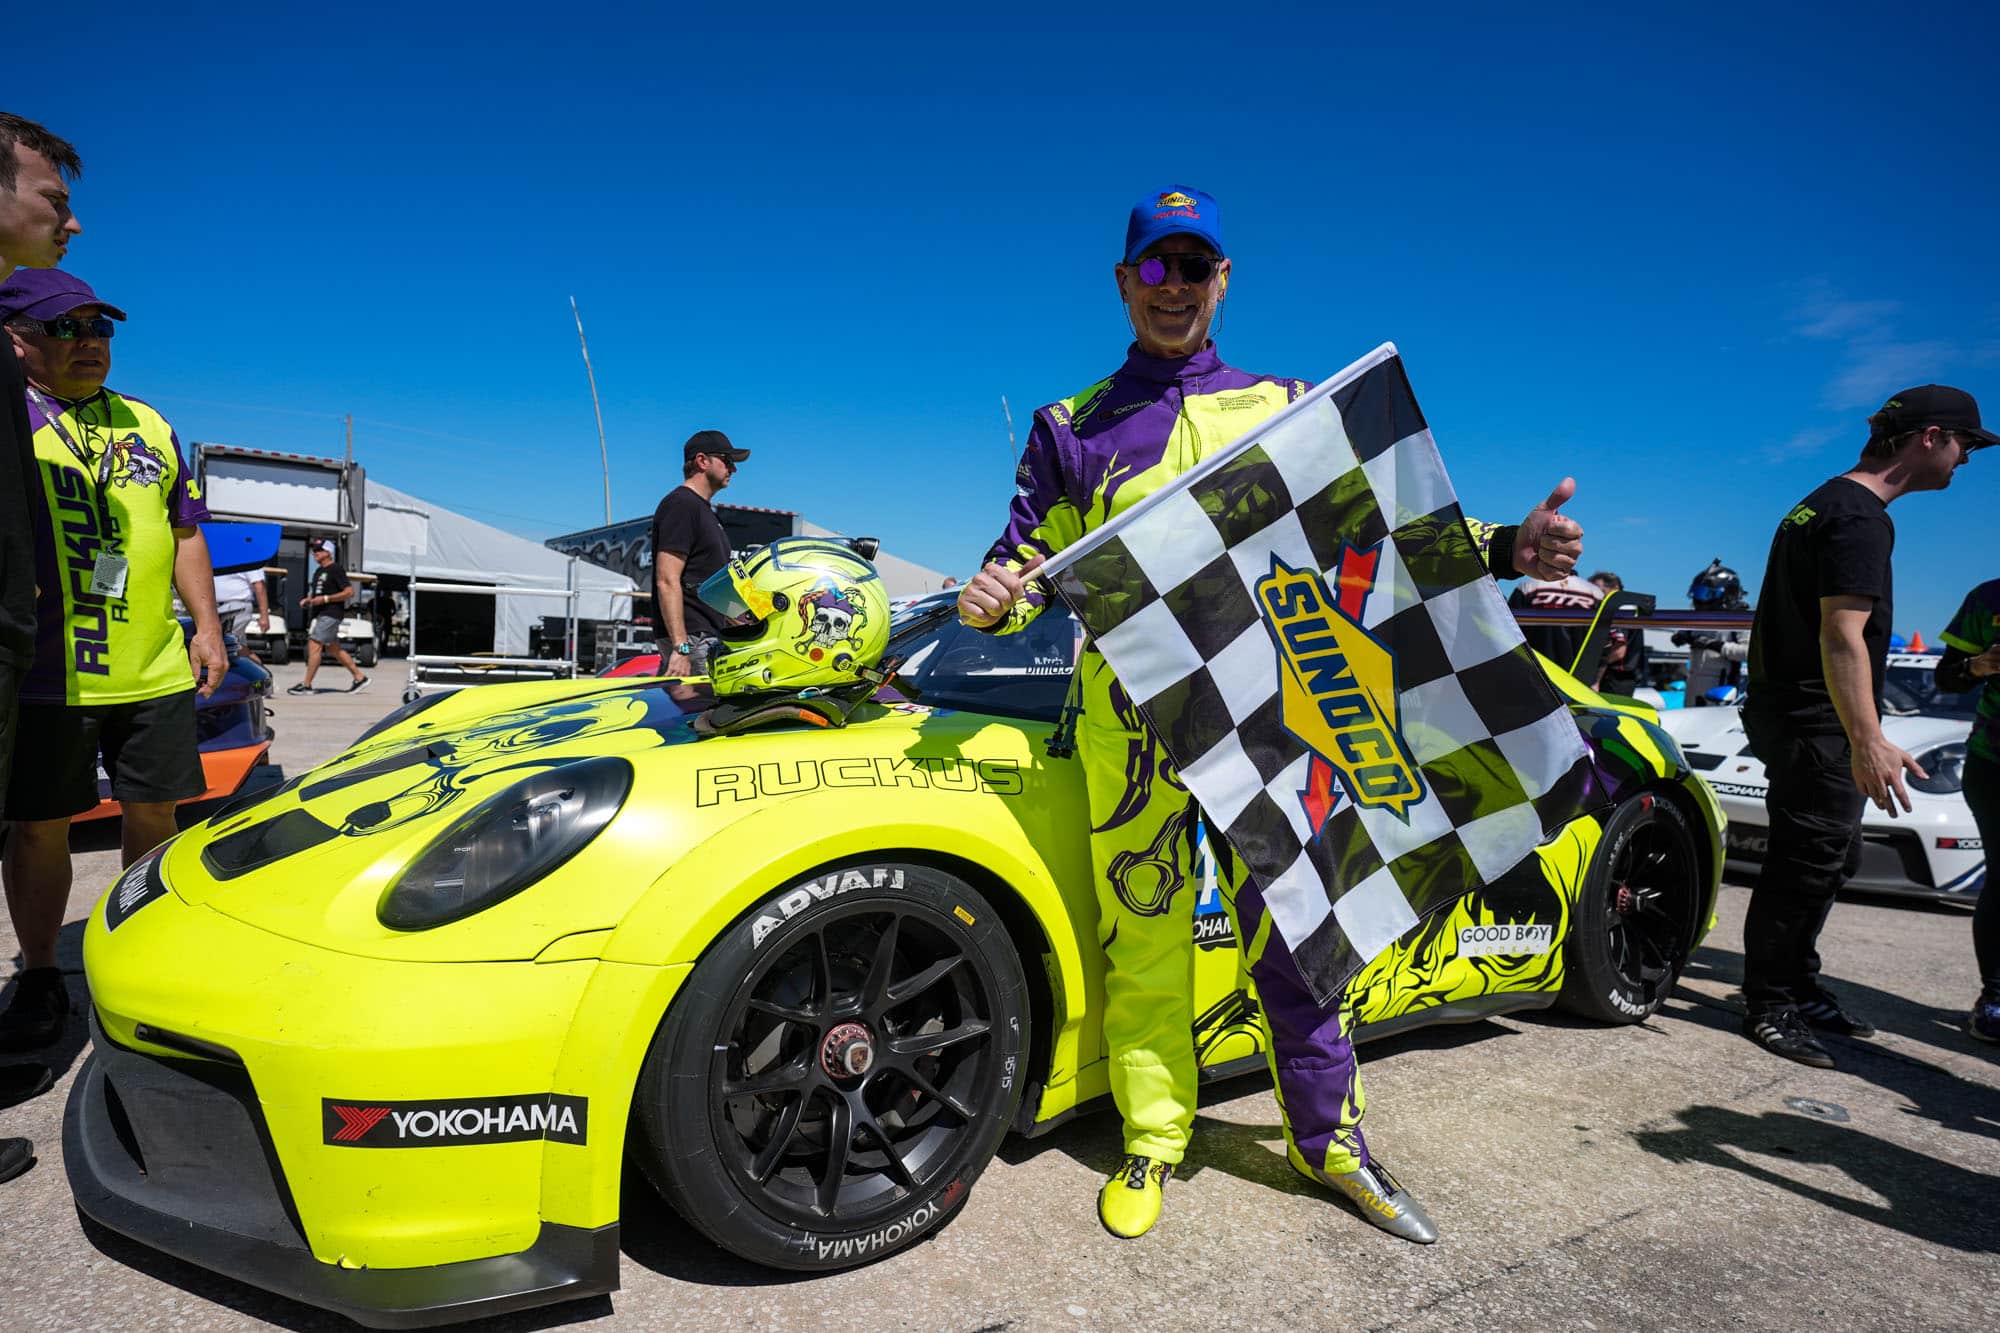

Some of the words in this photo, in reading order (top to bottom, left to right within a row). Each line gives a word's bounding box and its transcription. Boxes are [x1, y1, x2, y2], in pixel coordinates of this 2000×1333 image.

[1155, 195, 1198, 208] SUNOCO
[1113, 401, 1154, 416] YOKOHAMA
[1265, 581, 1413, 797] SUNOCO
[696, 757, 1024, 808] RUCKUS
[751, 867, 905, 950] ADVAN
[1461, 926, 1511, 944] GOOD
[391, 1104, 579, 1138] YOKOHAMA
[1337, 1172, 1397, 1219] UCKUS
[818, 1201, 940, 1260] YOKOHAMA
